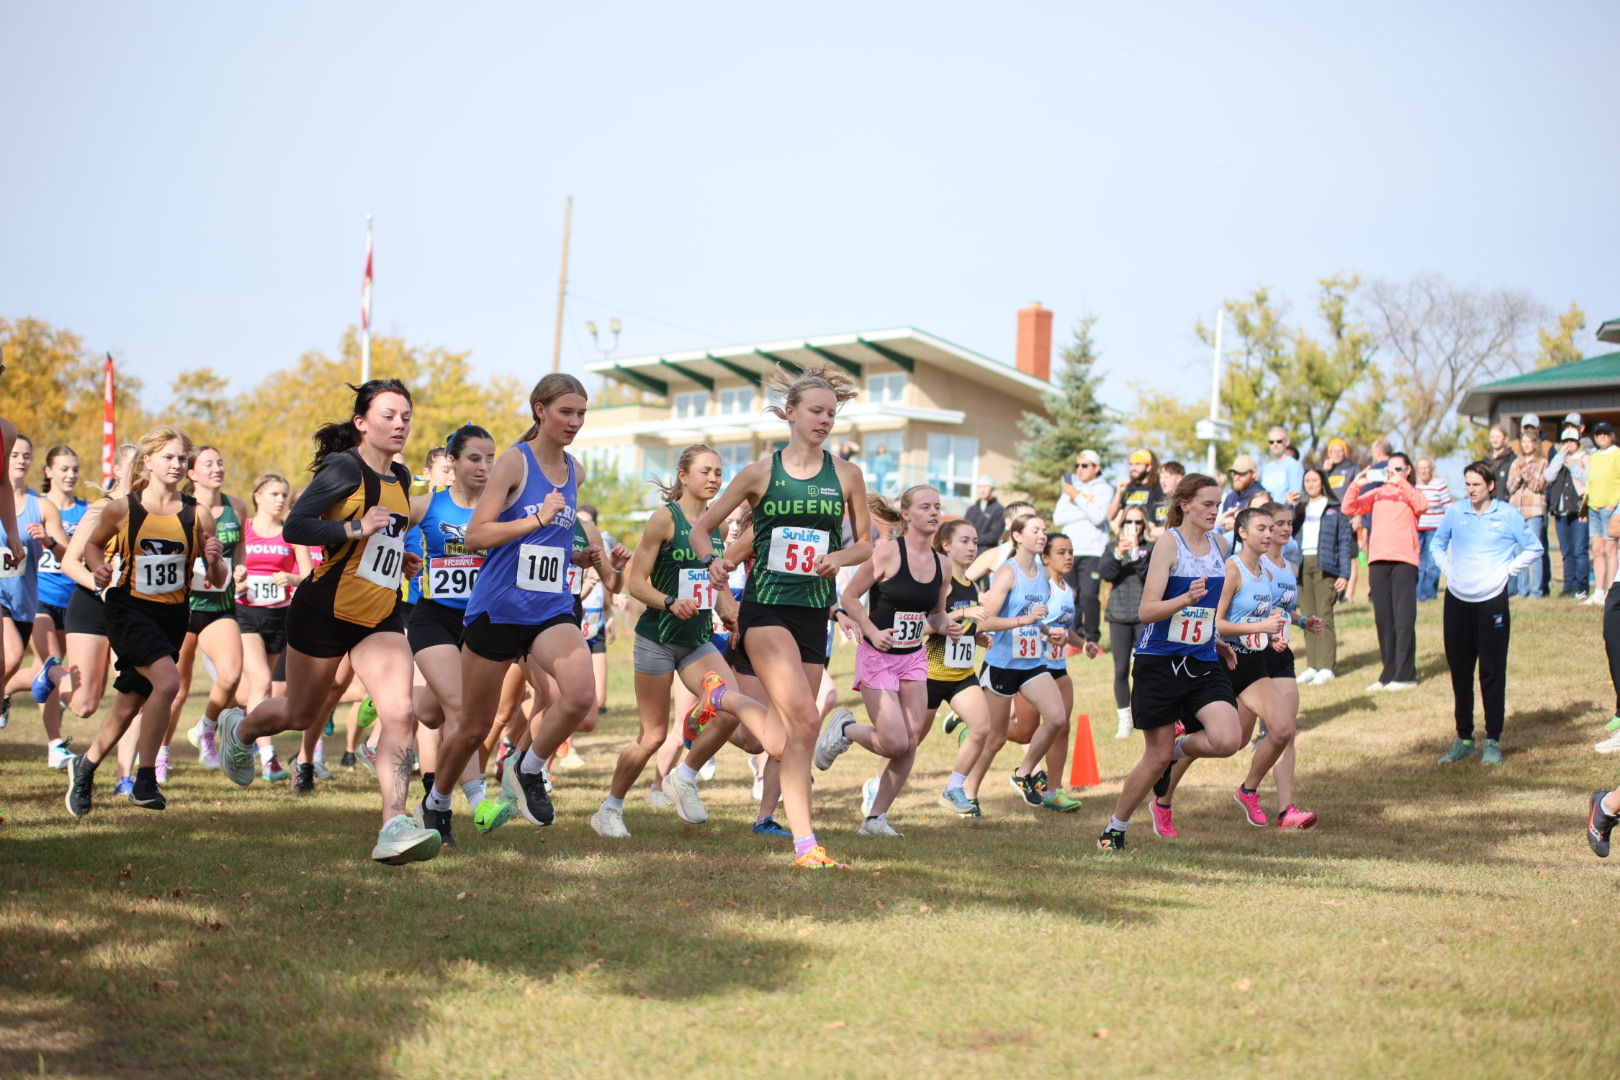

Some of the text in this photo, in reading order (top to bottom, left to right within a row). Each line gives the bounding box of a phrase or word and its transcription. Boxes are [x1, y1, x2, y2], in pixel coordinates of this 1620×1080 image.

[763, 500, 842, 516] QUEENS
[782, 527, 820, 543] SunLife
[784, 543, 816, 573] 53
[143, 562, 177, 586] 138
[528, 555, 558, 582] 100
[253, 583, 278, 599] 150
[693, 583, 713, 608] 51
[899, 620, 924, 640] 330
[1181, 620, 1203, 643] 15
[952, 642, 972, 661] 176
[1020, 638, 1036, 657] 39
